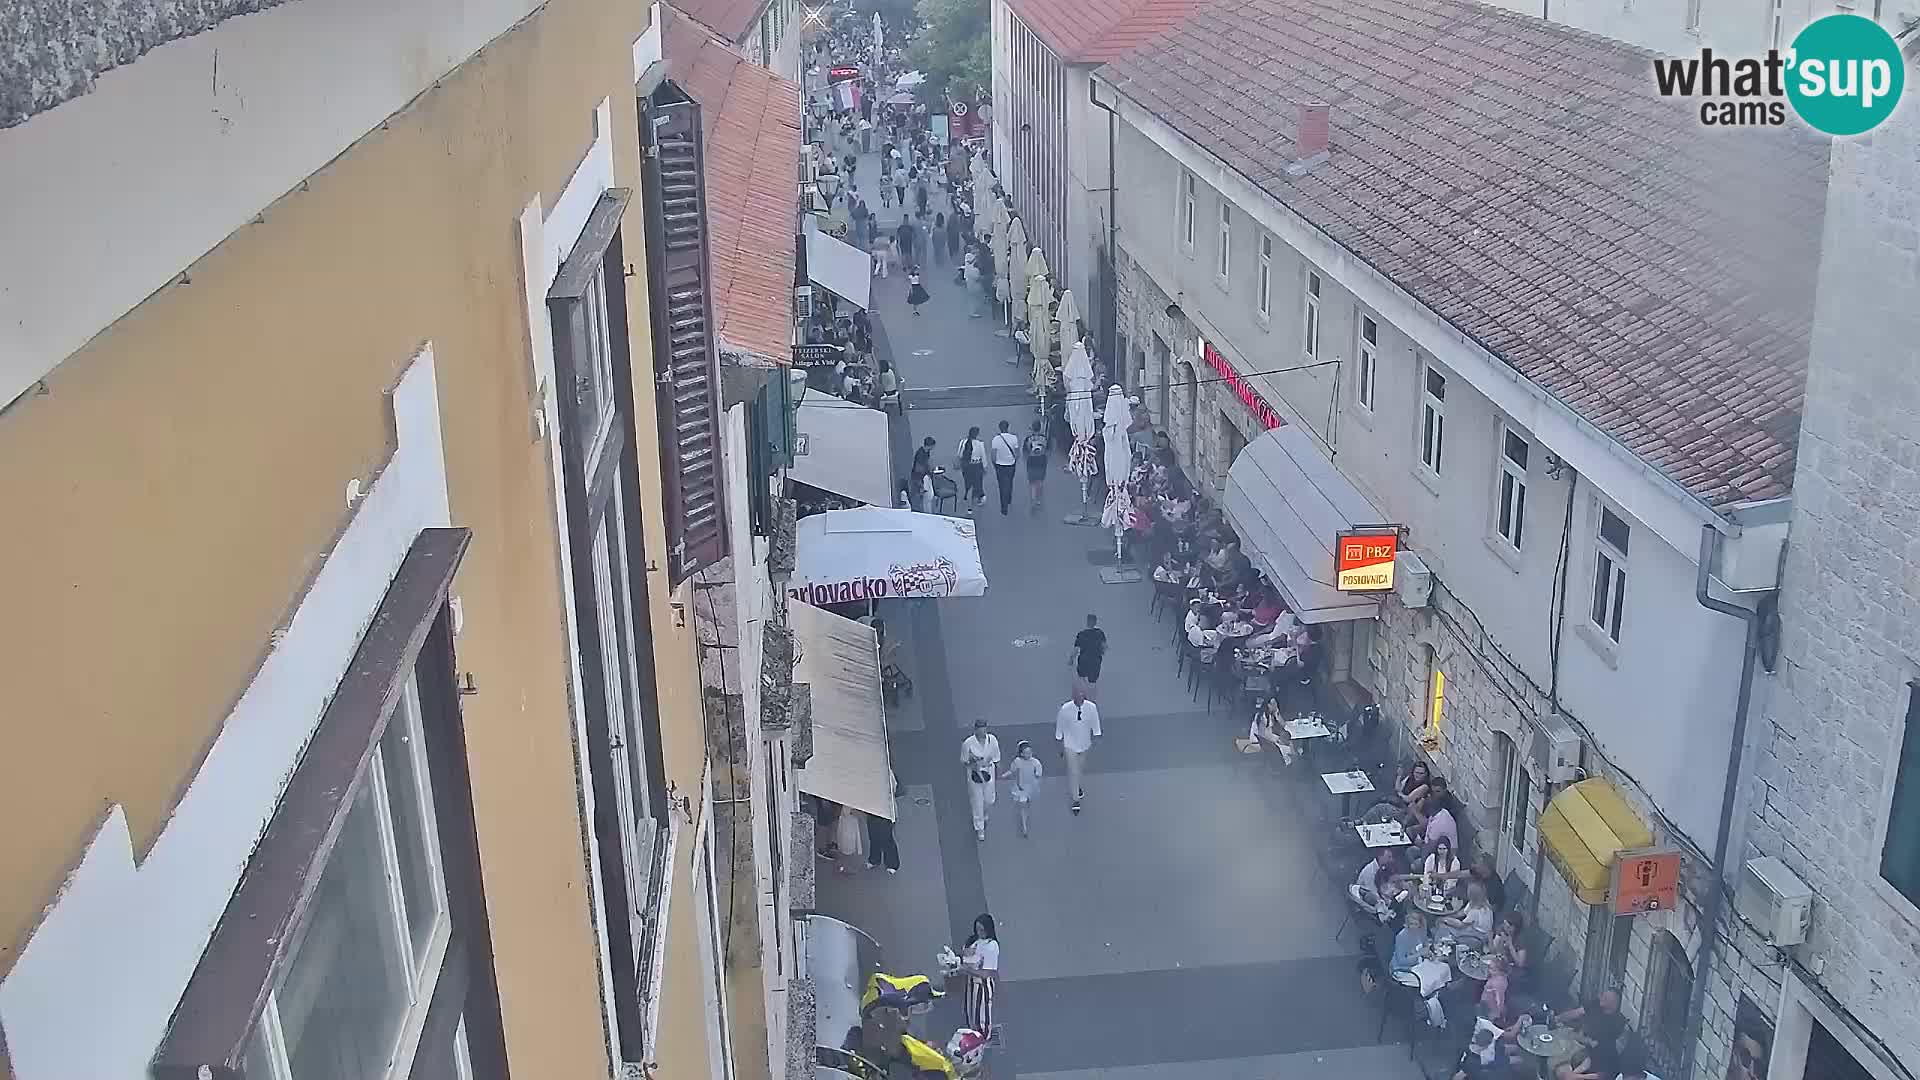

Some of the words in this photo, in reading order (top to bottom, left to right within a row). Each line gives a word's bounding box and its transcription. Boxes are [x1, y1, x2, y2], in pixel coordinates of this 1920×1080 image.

[1366, 546, 1392, 558] PBZ
[1343, 574, 1388, 585] POSLOVNICA
[788, 576, 887, 605] arlovačko
